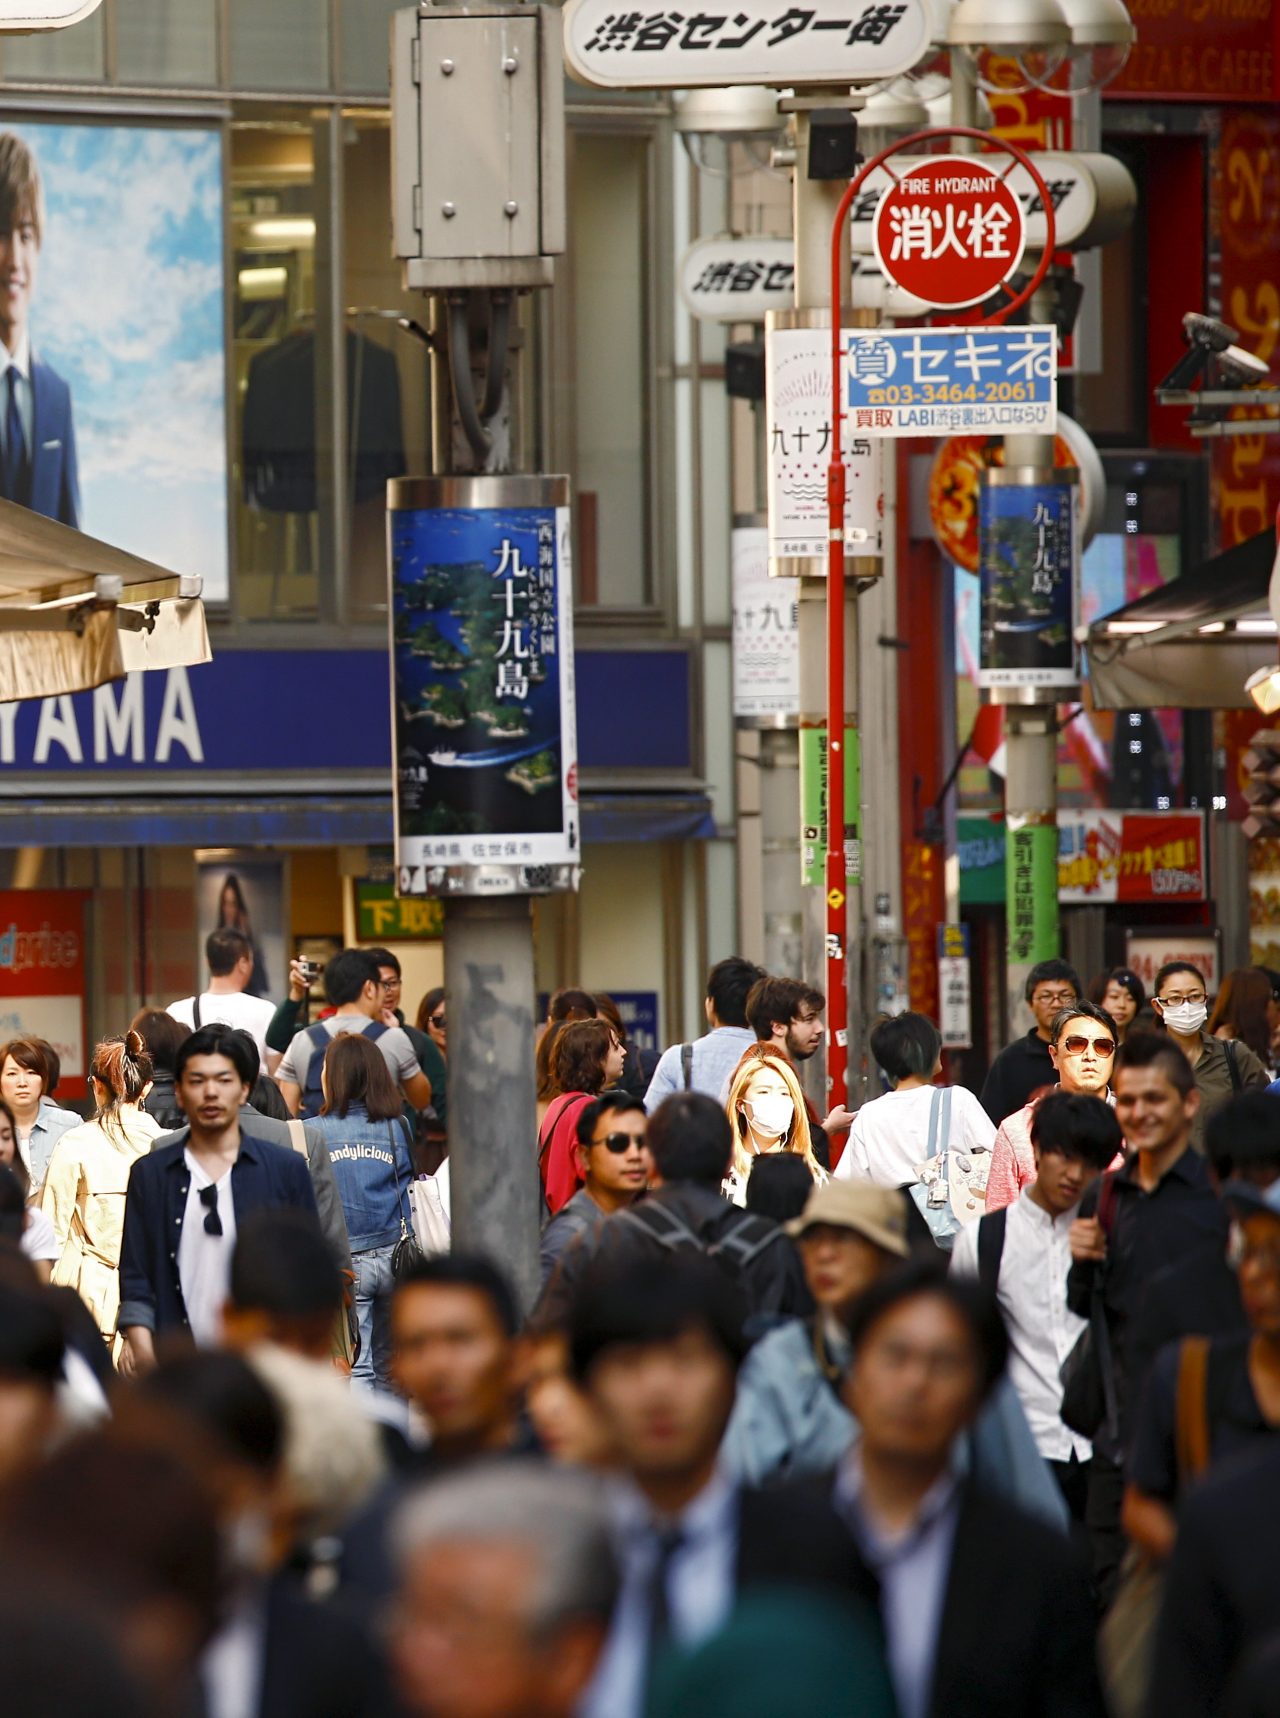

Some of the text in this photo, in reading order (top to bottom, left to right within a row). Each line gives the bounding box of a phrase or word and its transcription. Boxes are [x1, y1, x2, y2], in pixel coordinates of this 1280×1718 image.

[584, 5, 908, 52] 渋谷センター街
[900, 176, 997, 195] FIRE HYDRANT
[889, 202, 1012, 261] 消火栓
[902, 333, 1052, 383] セキネ
[886, 382, 1036, 405] 03-3464-2061
[856, 409, 893, 428] 買取
[492, 539, 529, 700] 九十九島
